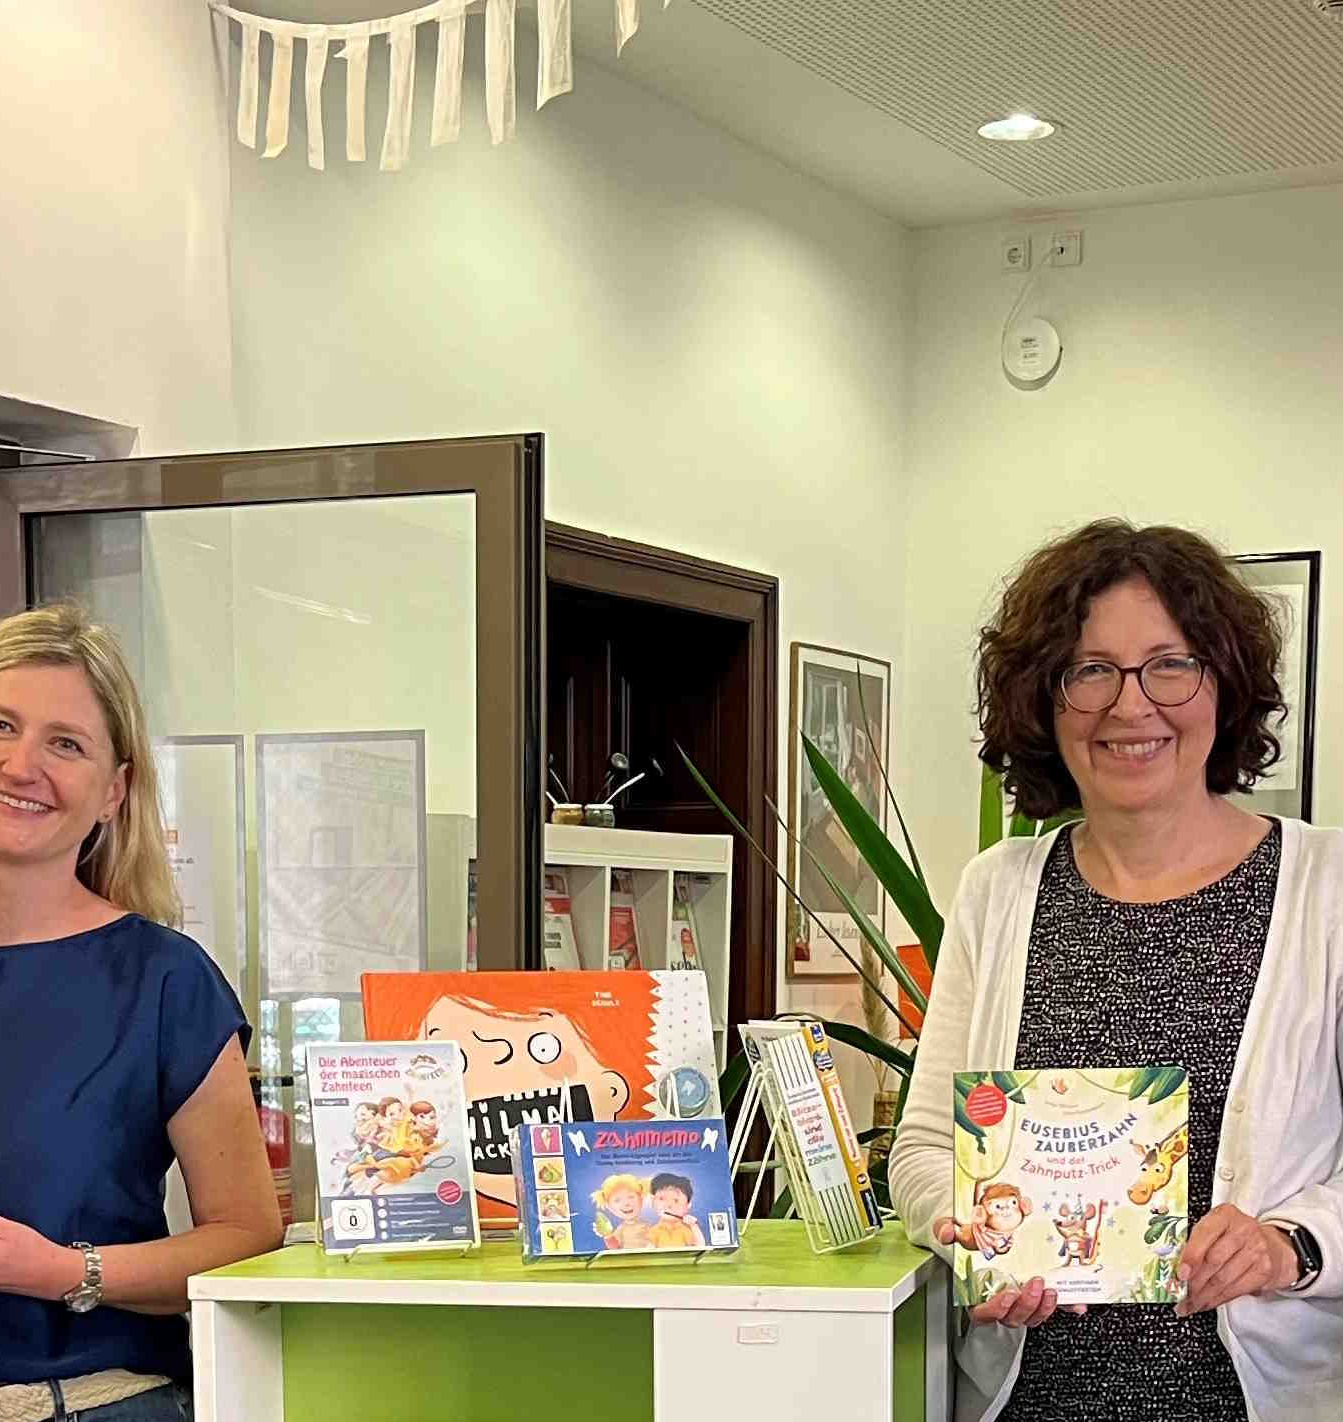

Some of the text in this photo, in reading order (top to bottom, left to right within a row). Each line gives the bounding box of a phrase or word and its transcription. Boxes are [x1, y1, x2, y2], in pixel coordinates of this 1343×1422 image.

[318, 1055, 398, 1068] Die Abenteuer
[320, 1068, 401, 1081] der magischen
[321, 1081, 373, 1093] Zahnfeen
[1020, 1117, 1100, 1139] EUSEBIUS
[1034, 1112, 1138, 1153] ZAUBERZAHN
[1020, 1155, 1122, 1182] Zahnputz-Trick
[349, 1215, 358, 1227] 0
